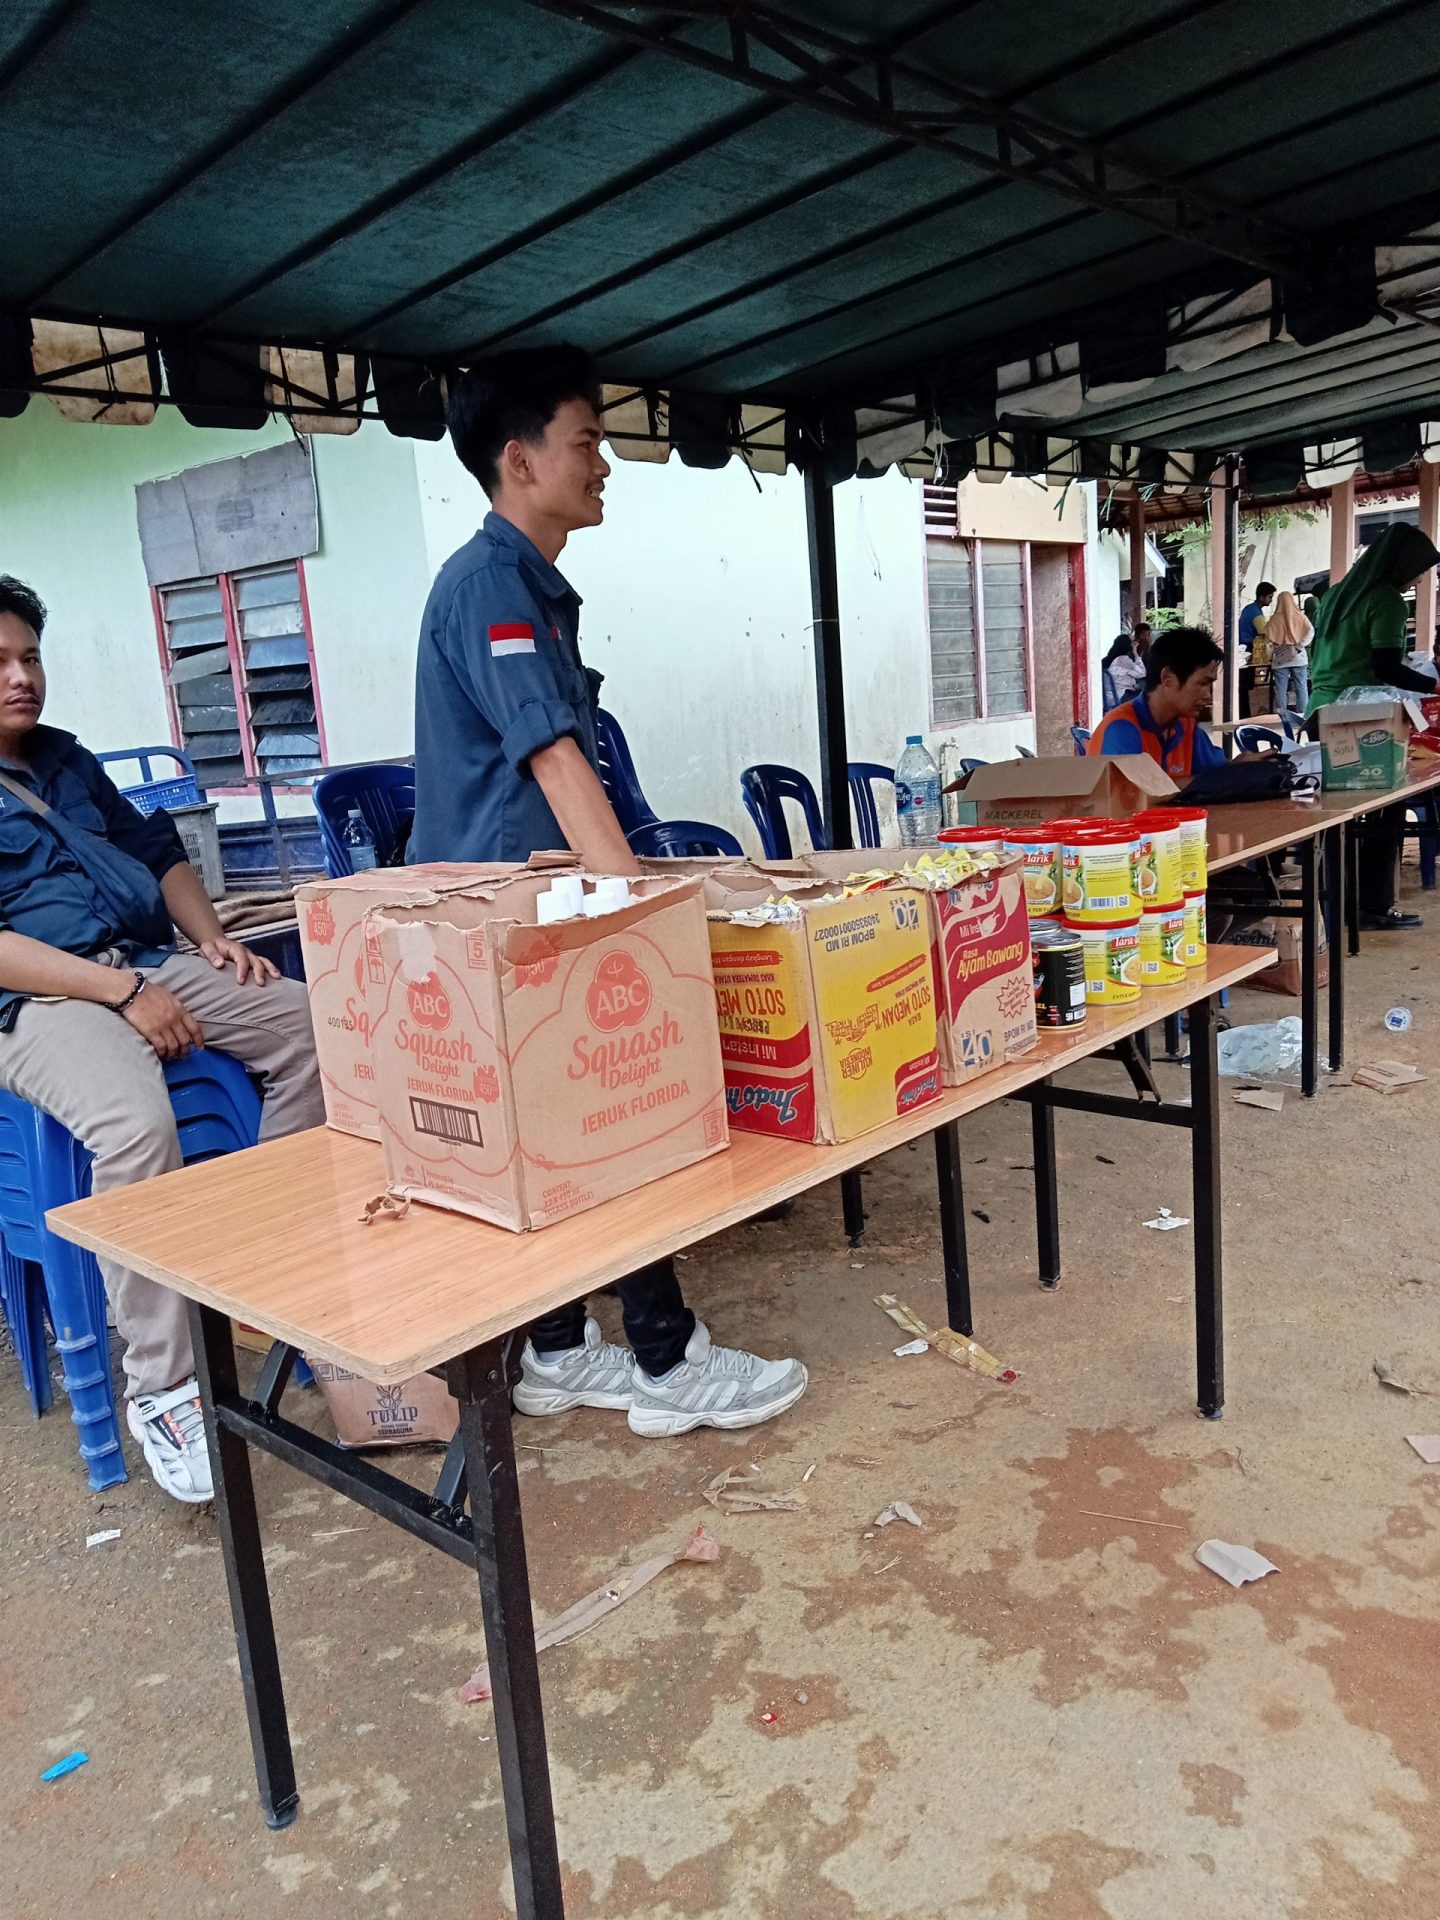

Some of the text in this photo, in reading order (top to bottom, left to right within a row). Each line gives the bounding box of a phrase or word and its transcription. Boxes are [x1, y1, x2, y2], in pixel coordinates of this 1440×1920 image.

[984, 809, 1044, 820] MACKEREL
[891, 898, 920, 931] 40
[313, 921, 327, 937] 450
[825, 928, 876, 953] BPOM RI MD
[959, 922, 981, 938] Mi Ins
[472, 941, 484, 959] 5
[721, 954, 745, 964] dengan
[745, 953, 773, 963] Lengkap
[956, 954, 986, 983] Ayam
[986, 941, 1024, 969] Bawang
[962, 948, 979, 960] Rasa
[412, 992, 449, 1018] ABC
[594, 978, 645, 1020] ABC
[745, 987, 787, 1017] SOTO
[911, 985, 932, 1012] SOTO
[881, 997, 912, 1029] MEDAN
[908, 1013, 922, 1027] RASA
[395, 1019, 477, 1067] Squash
[1003, 1025, 1020, 1042] BPOM
[566, 1010, 685, 1089] Squash
[722, 1039, 777, 1061] Mi Instan
[839, 1045, 872, 1070] INDONESIA
[962, 1030, 993, 1067] 40
[354, 1063, 375, 1081] JER
[422, 1055, 461, 1082] Delight
[609, 1056, 662, 1091] Delight
[842, 1057, 873, 1080] KULINER
[407, 1076, 476, 1104] JERUK FLORIDA
[580, 1079, 691, 1137] JERUK FLORIDA
[725, 1083, 809, 1126] Indom
[366, 1406, 419, 1426] TULIP
